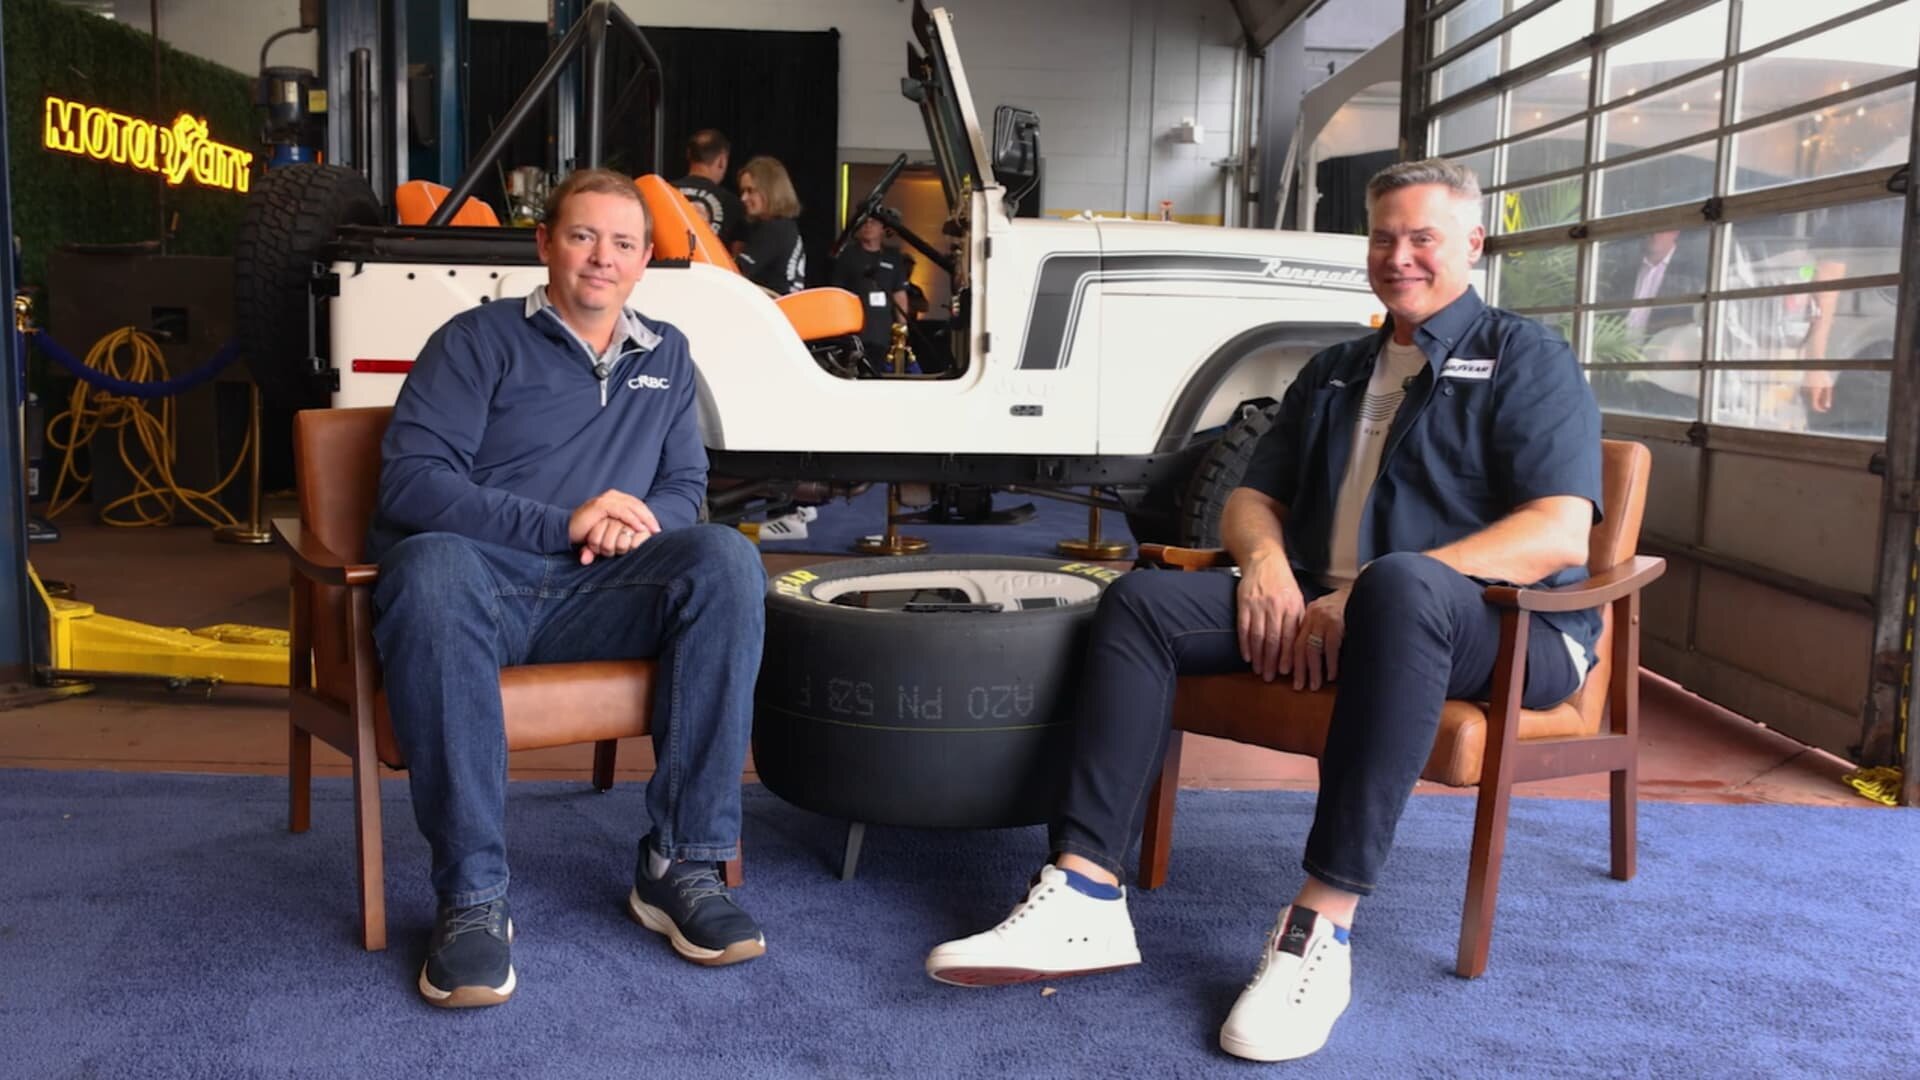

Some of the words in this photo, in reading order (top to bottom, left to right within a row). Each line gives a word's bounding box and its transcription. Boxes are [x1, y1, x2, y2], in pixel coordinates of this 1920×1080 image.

[45, 96, 176, 174] MOTOR
[193, 138, 253, 193] CITY
[898, 685, 943, 720] PN
